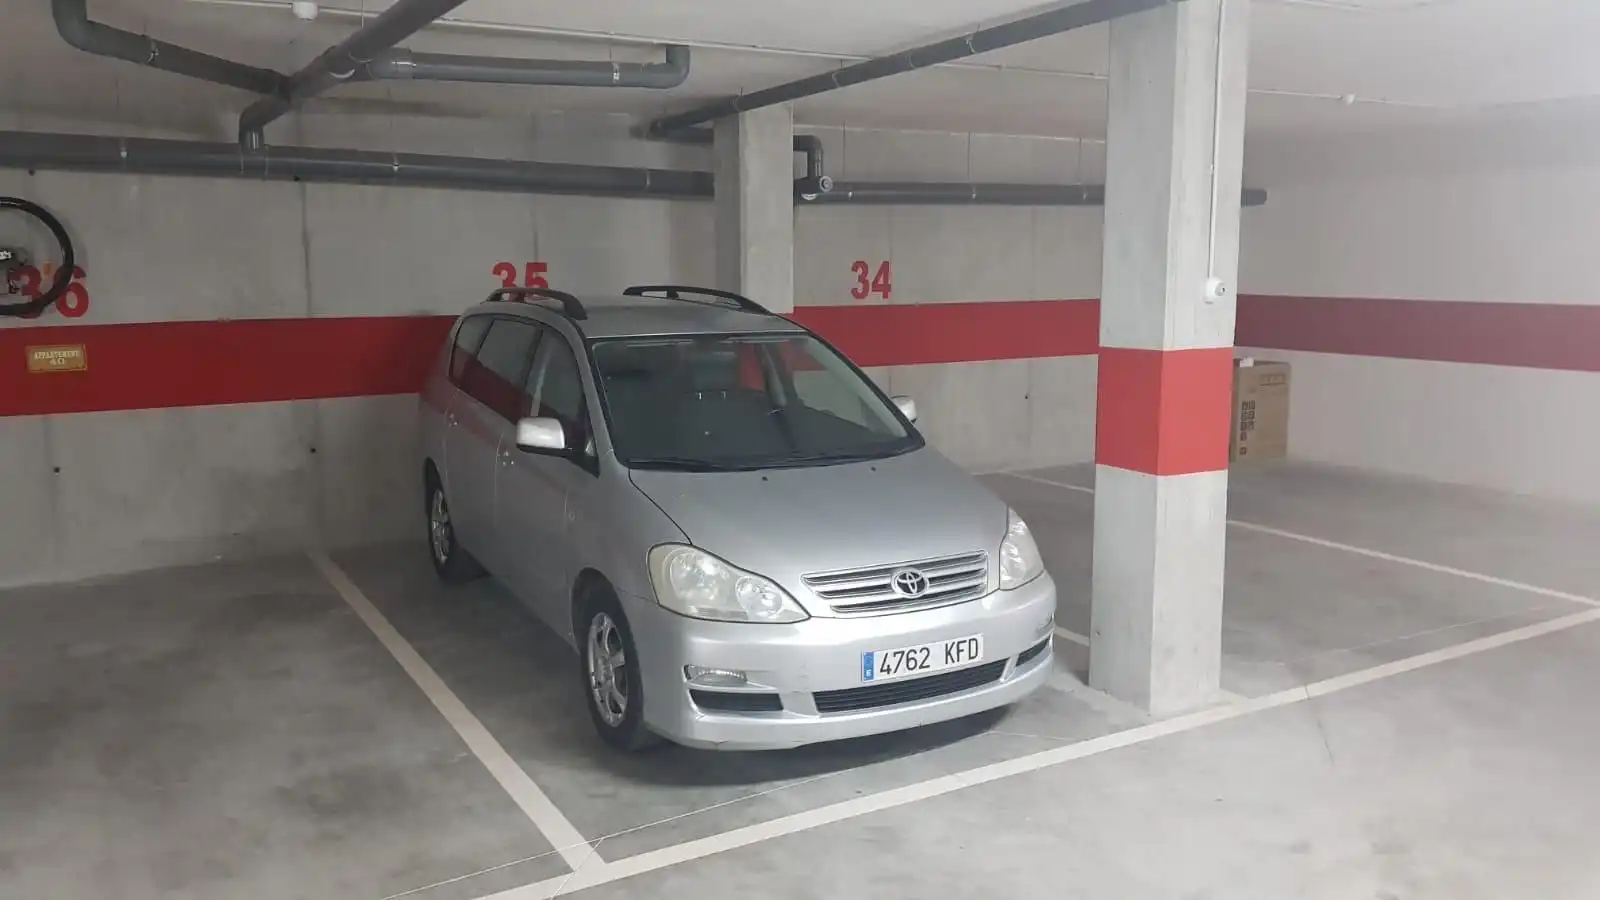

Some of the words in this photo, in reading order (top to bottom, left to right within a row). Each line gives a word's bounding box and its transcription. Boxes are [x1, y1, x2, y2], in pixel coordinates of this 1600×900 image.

[851, 261, 891, 300] 34
[879, 647, 931, 675] 4762
[944, 638, 979, 665] KFD
